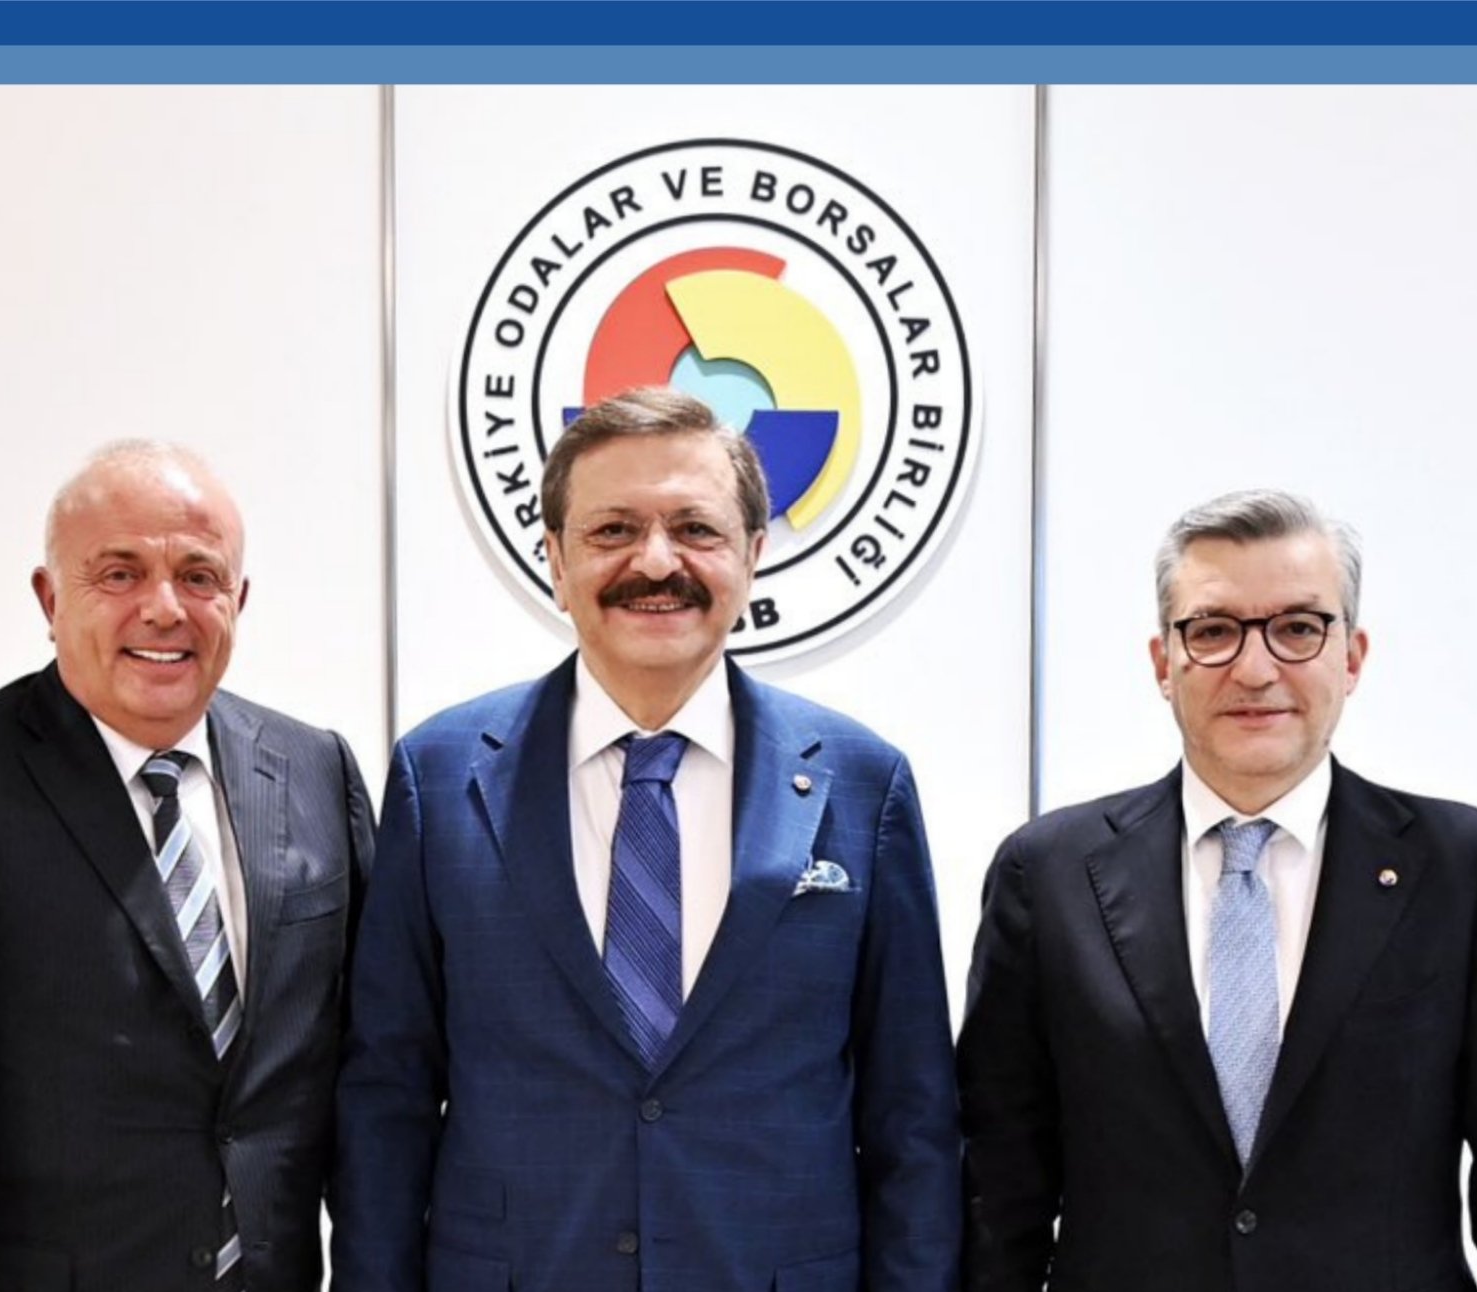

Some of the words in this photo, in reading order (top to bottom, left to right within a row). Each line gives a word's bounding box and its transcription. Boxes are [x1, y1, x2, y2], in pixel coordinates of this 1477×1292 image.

[495, 185, 642, 348] ODALAR
[662, 167, 723, 200] VE
[751, 170, 940, 379] BORSALAR
[483, 374, 551, 562] RKİYE
[835, 404, 944, 585] BİRLİĞİ
